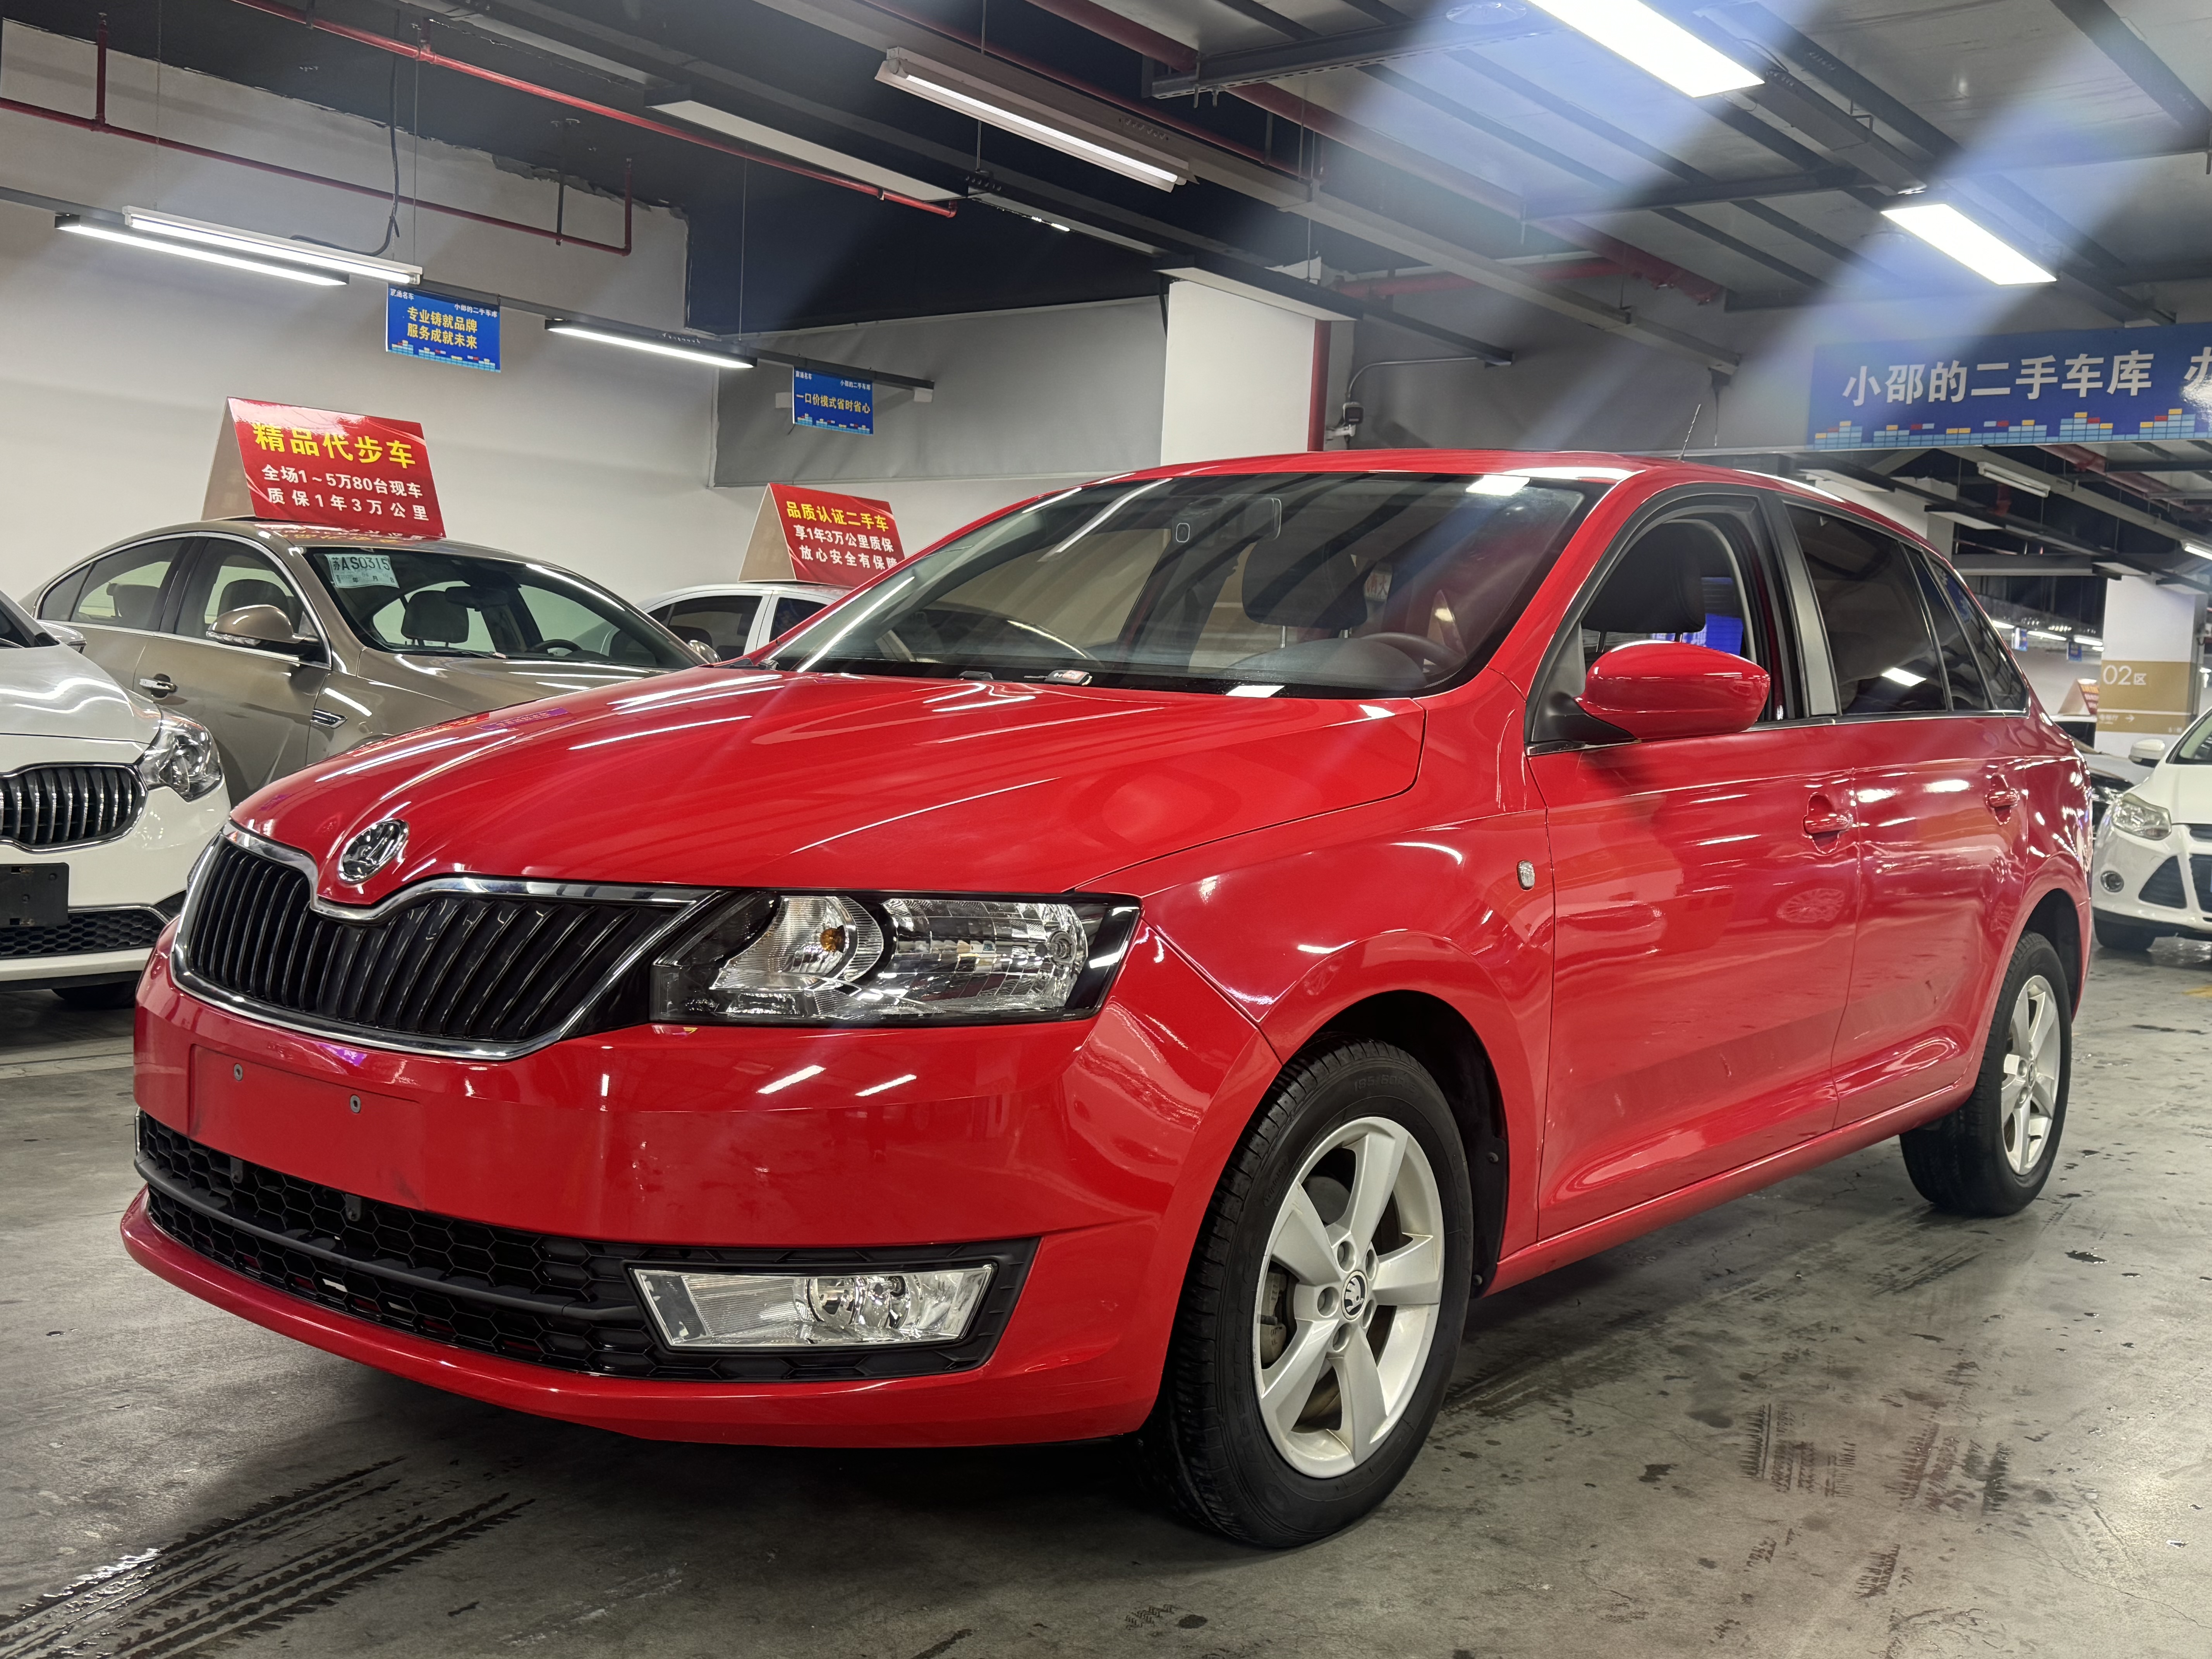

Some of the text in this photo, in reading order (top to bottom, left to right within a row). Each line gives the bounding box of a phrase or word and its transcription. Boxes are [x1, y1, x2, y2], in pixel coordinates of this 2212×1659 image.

[407, 306, 477, 333] 专业铸就品牌
[407, 323, 477, 349] 服务成就未来
[1843, 350, 2154, 406] 小邵的二手车库
[796, 393, 871, 414] 一口价模式省时省心
[253, 422, 416, 469] 精品代步车
[786, 501, 889, 532] 品质认证二手车
[793, 525, 894, 553] 享1年3万公里质保
